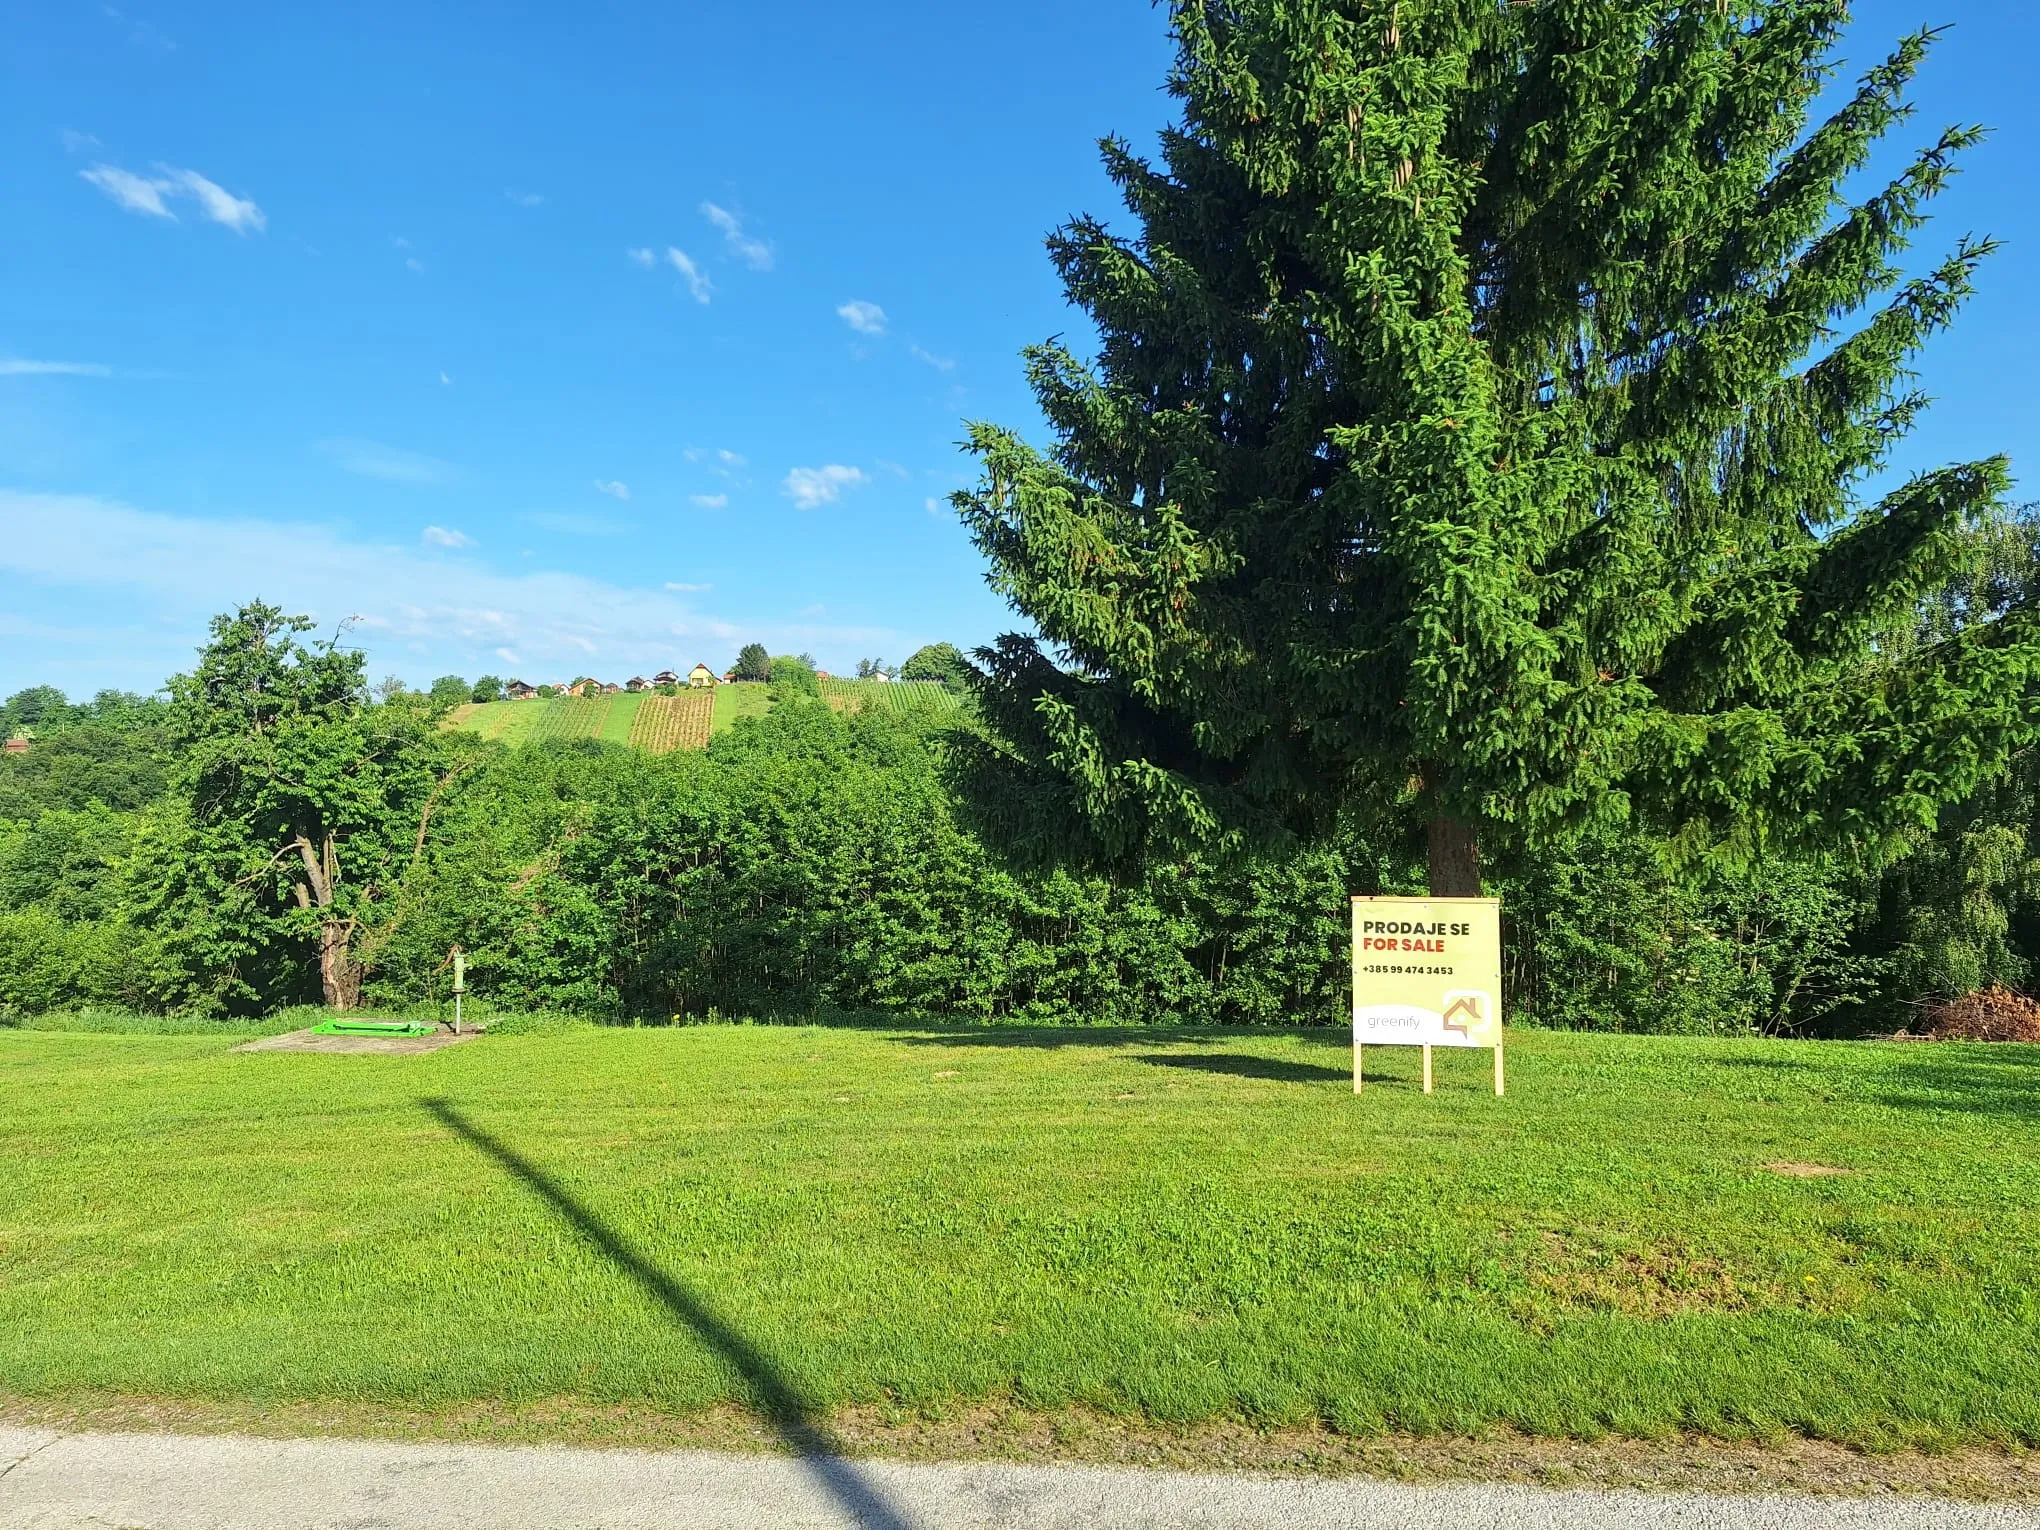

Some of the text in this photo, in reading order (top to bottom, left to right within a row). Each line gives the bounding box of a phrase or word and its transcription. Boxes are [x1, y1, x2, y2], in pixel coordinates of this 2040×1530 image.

[1364, 921, 1470, 935] PRODAJE SE
[1364, 938, 1445, 952] FOR SALE
[1363, 965, 1388, 973] +385
[1405, 966, 1424, 974] 474
[1426, 966, 1453, 975] 3453
[1367, 1015, 1420, 1029] greenify
